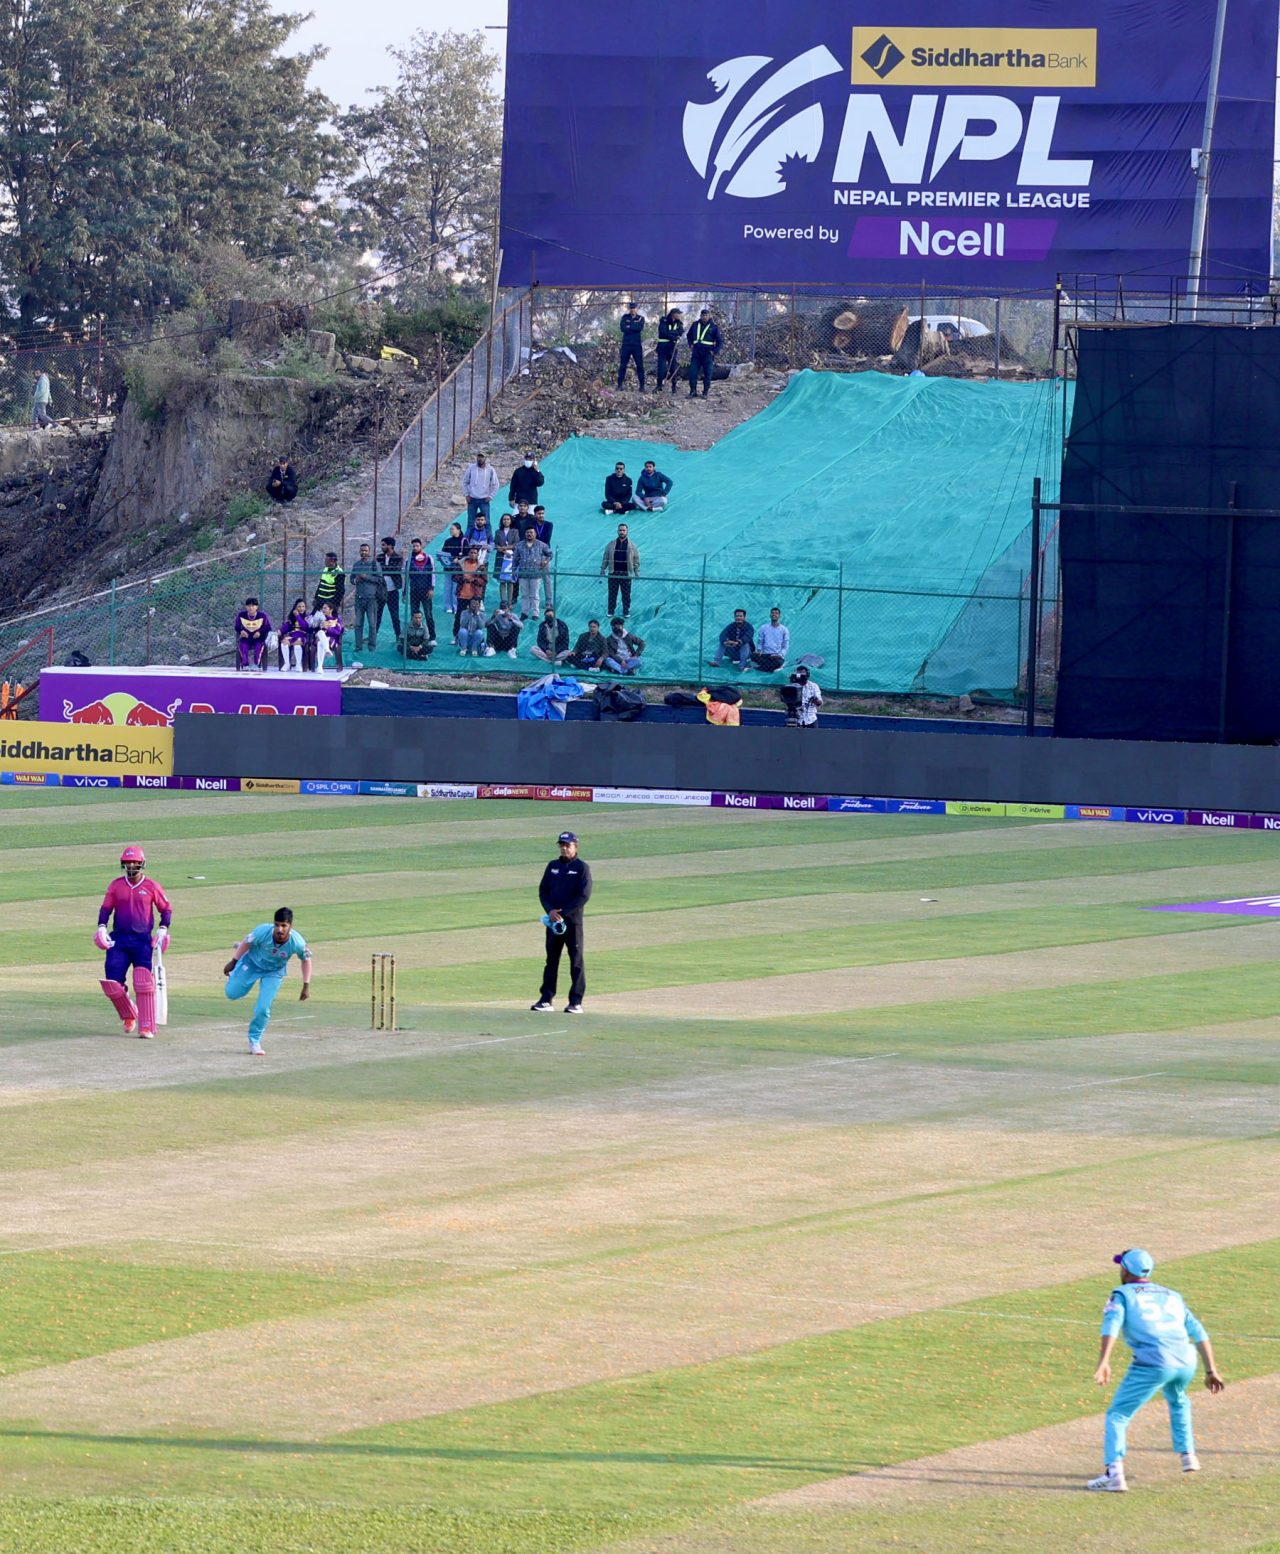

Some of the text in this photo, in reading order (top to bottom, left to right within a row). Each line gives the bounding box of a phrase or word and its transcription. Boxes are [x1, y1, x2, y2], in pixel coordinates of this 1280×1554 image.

[910, 47, 1088, 70] SiddharthaBank
[832, 94, 1093, 185] NPL
[834, 190, 1090, 208] NEPAL PREMIER LEAGUE
[744, 224, 839, 243] Powered by
[899, 220, 1005, 256] Ncell
[15, 774, 45, 783] WAI WAI
[74, 777, 108, 786] vivo
[136, 776, 167, 787] Ncell
[196, 779, 226, 790] Ncell
[430, 788, 474, 799] Siddhartha Capital
[725, 794, 756, 807] Ncell
[784, 797, 814, 808] Ncell
[1080, 808, 1110, 817] WAI WAI
[1137, 811, 1173, 822] vivo
[1202, 813, 1234, 826] Ncell
